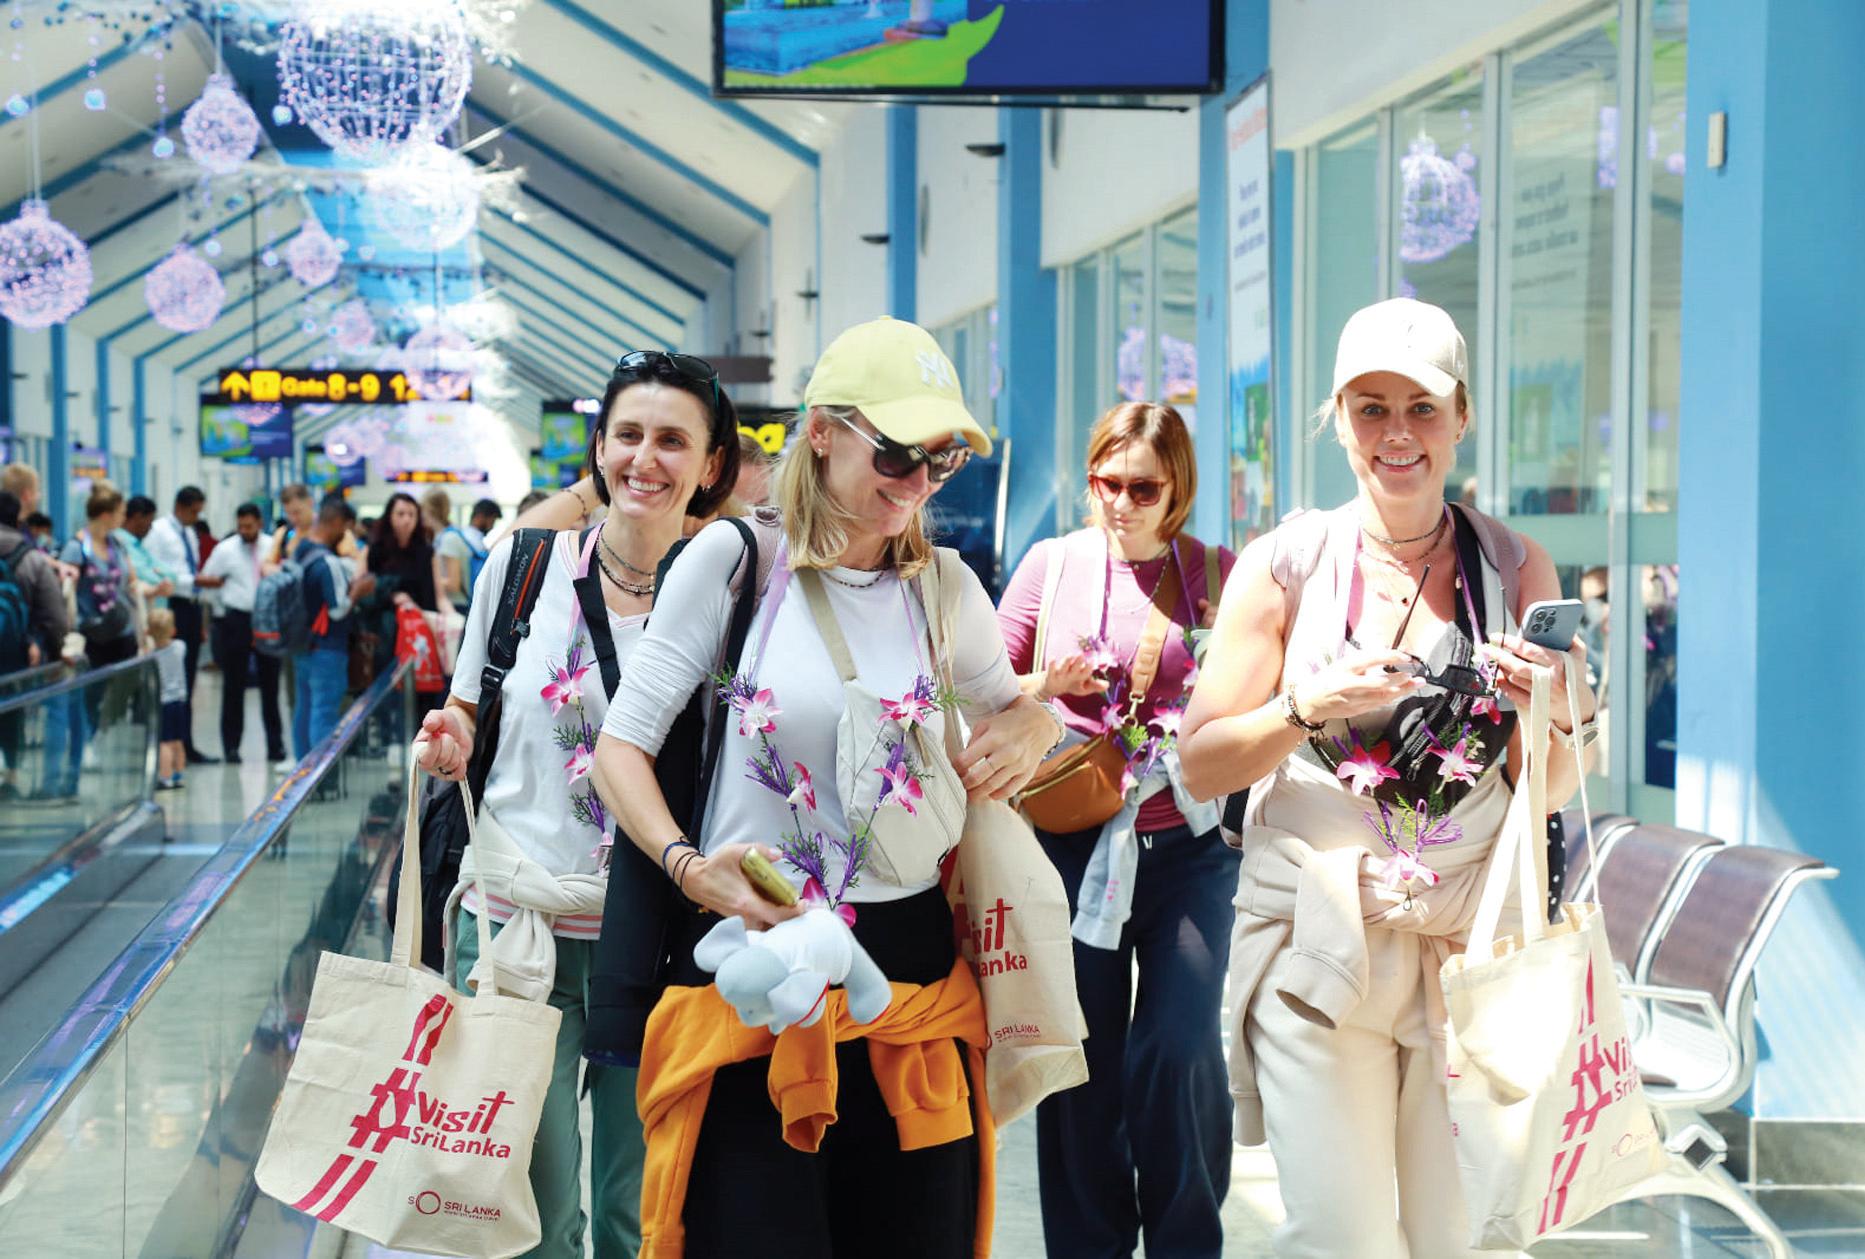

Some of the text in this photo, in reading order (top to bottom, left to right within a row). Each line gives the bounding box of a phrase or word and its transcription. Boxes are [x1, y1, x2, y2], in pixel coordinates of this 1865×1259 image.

[281, 376, 327, 397] Gate
[327, 373, 380, 402] 8-9
[410, 1126, 511, 1159] SriLanka
[444, 1201, 463, 1211] SRI
[463, 1203, 501, 1217] LANKA
